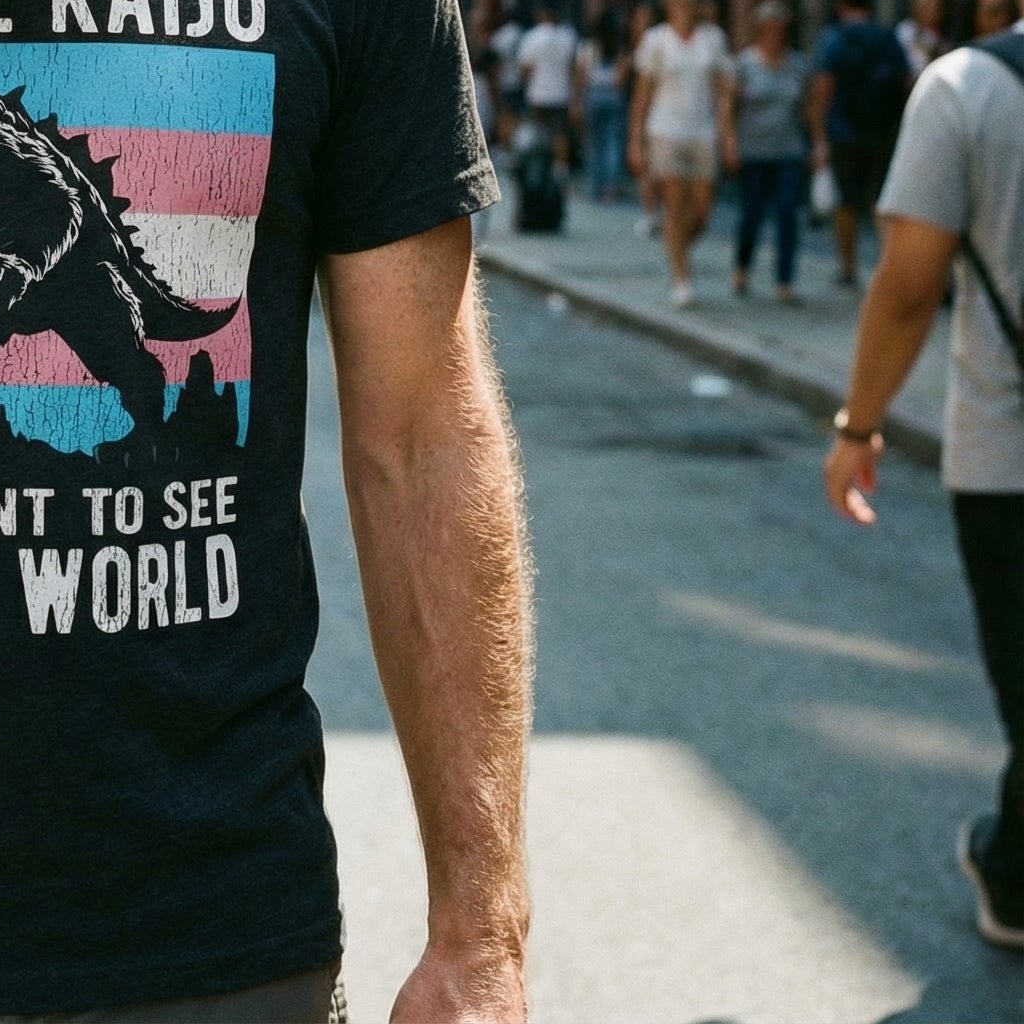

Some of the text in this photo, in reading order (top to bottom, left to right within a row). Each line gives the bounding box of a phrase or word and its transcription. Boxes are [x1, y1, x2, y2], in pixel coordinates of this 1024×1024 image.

[83, 487, 143, 535] TO
[163, 476, 237, 529] SEE
[19, 534, 239, 634] WORLD
